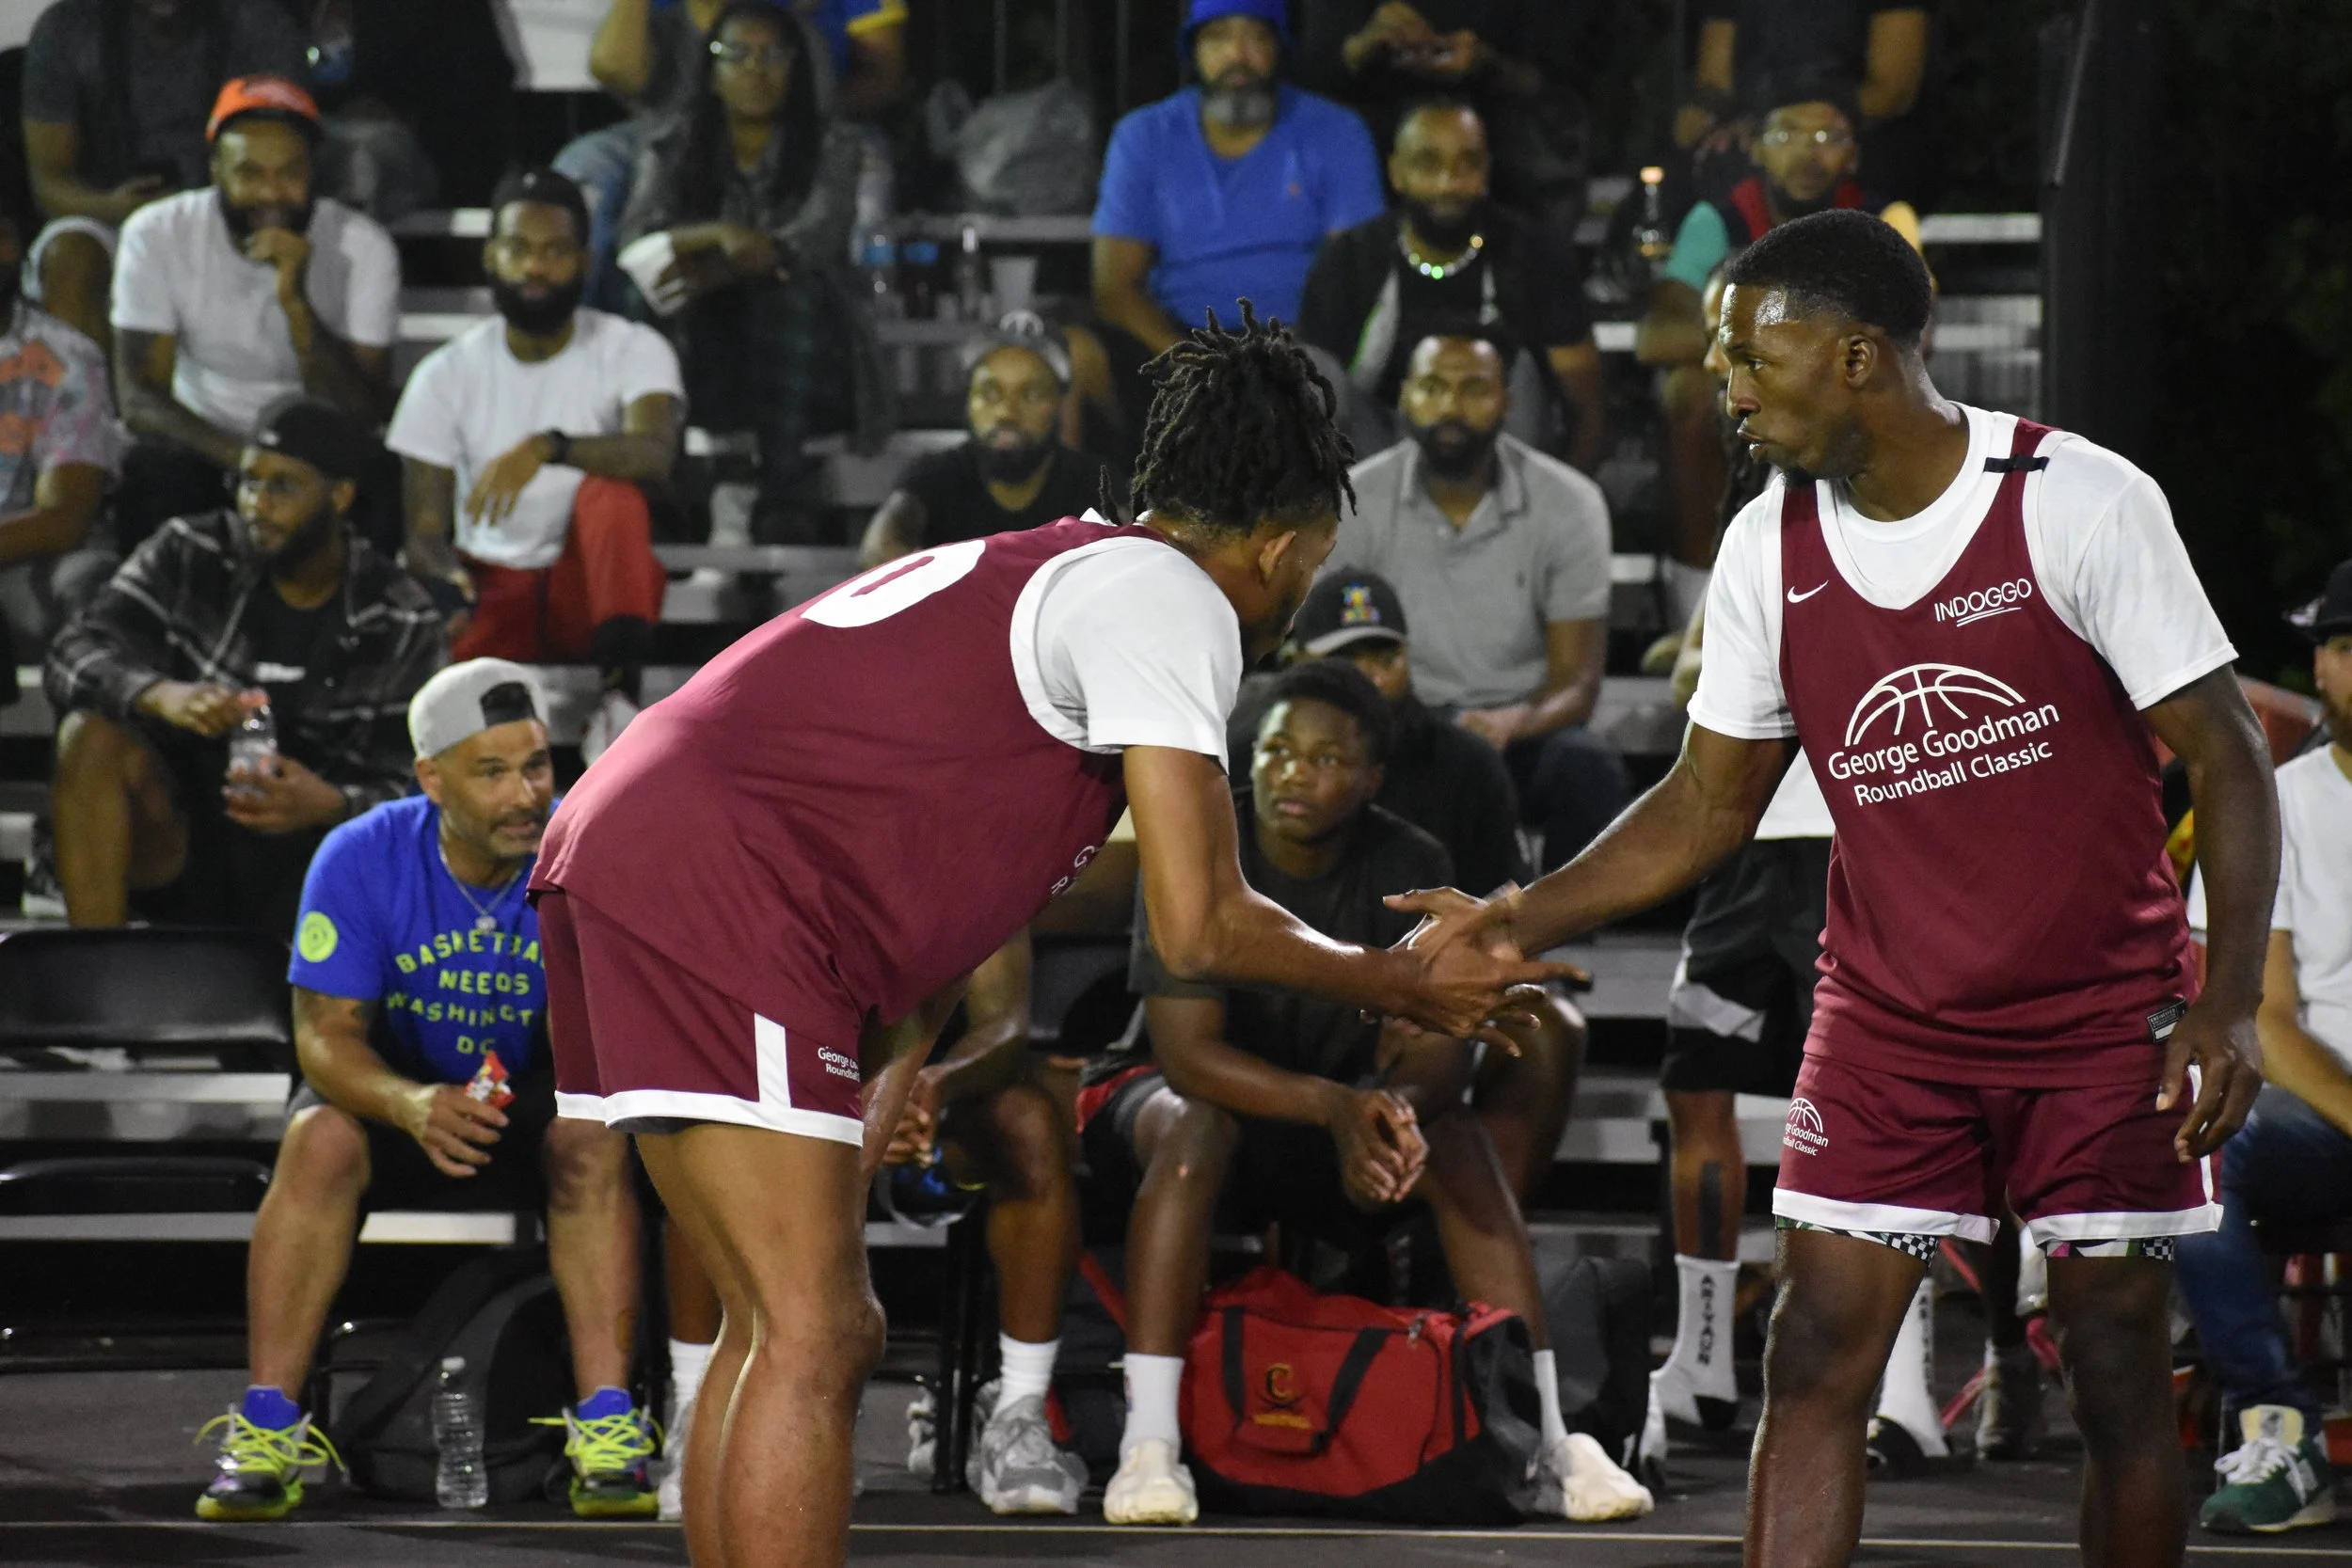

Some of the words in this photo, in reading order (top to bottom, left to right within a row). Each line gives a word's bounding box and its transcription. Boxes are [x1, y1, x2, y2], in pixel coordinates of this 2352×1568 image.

[1933, 578, 2032, 623] INDOGGO
[1828, 741, 1920, 780] George
[1922, 704, 2060, 755] Goodman
[1853, 762, 1967, 807] Roundball
[1970, 741, 2054, 779] Classic
[438, 969, 531, 996] NEEDS
[818, 1047, 849, 1068] George
[1790, 1123, 1829, 1148] Goodman
[1794, 1140, 1819, 1156] Classic
